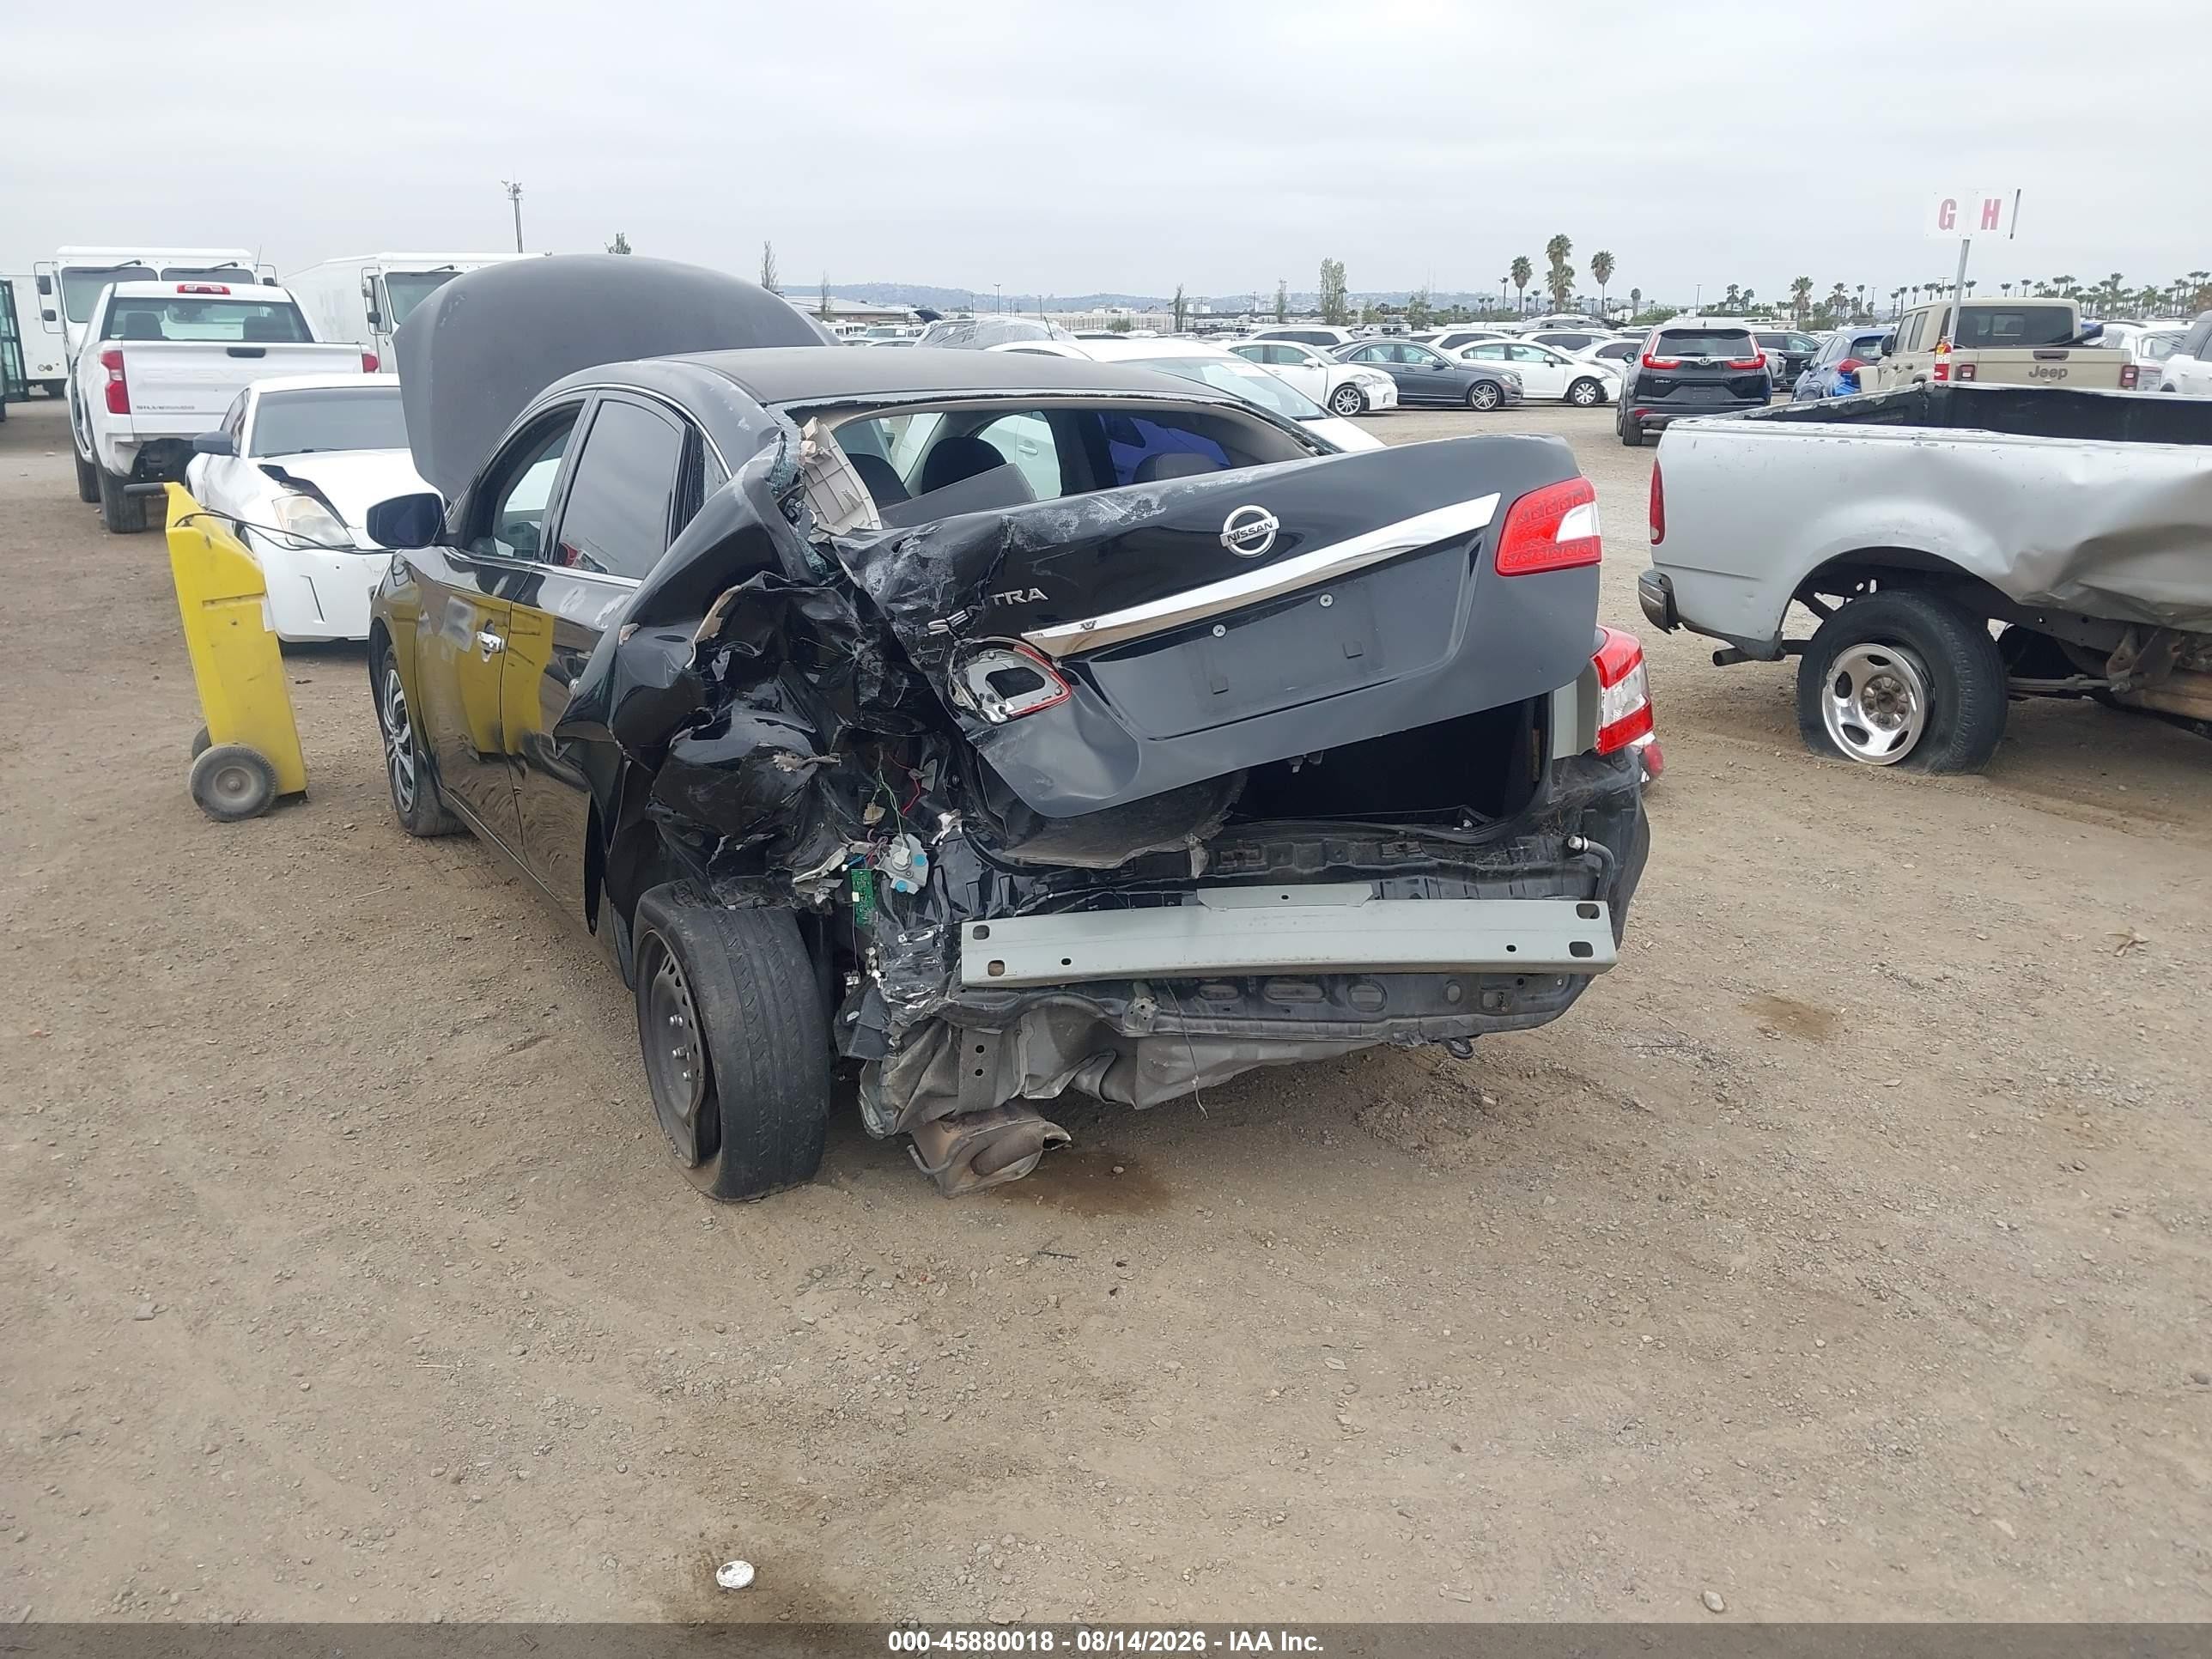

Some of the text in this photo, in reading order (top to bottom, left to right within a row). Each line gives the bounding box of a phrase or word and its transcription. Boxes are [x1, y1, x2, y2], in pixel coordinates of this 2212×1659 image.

[1938, 198, 2002, 230] G H
[2028, 365, 2069, 380] Jeep
[1226, 520, 1273, 544] NISSAN
